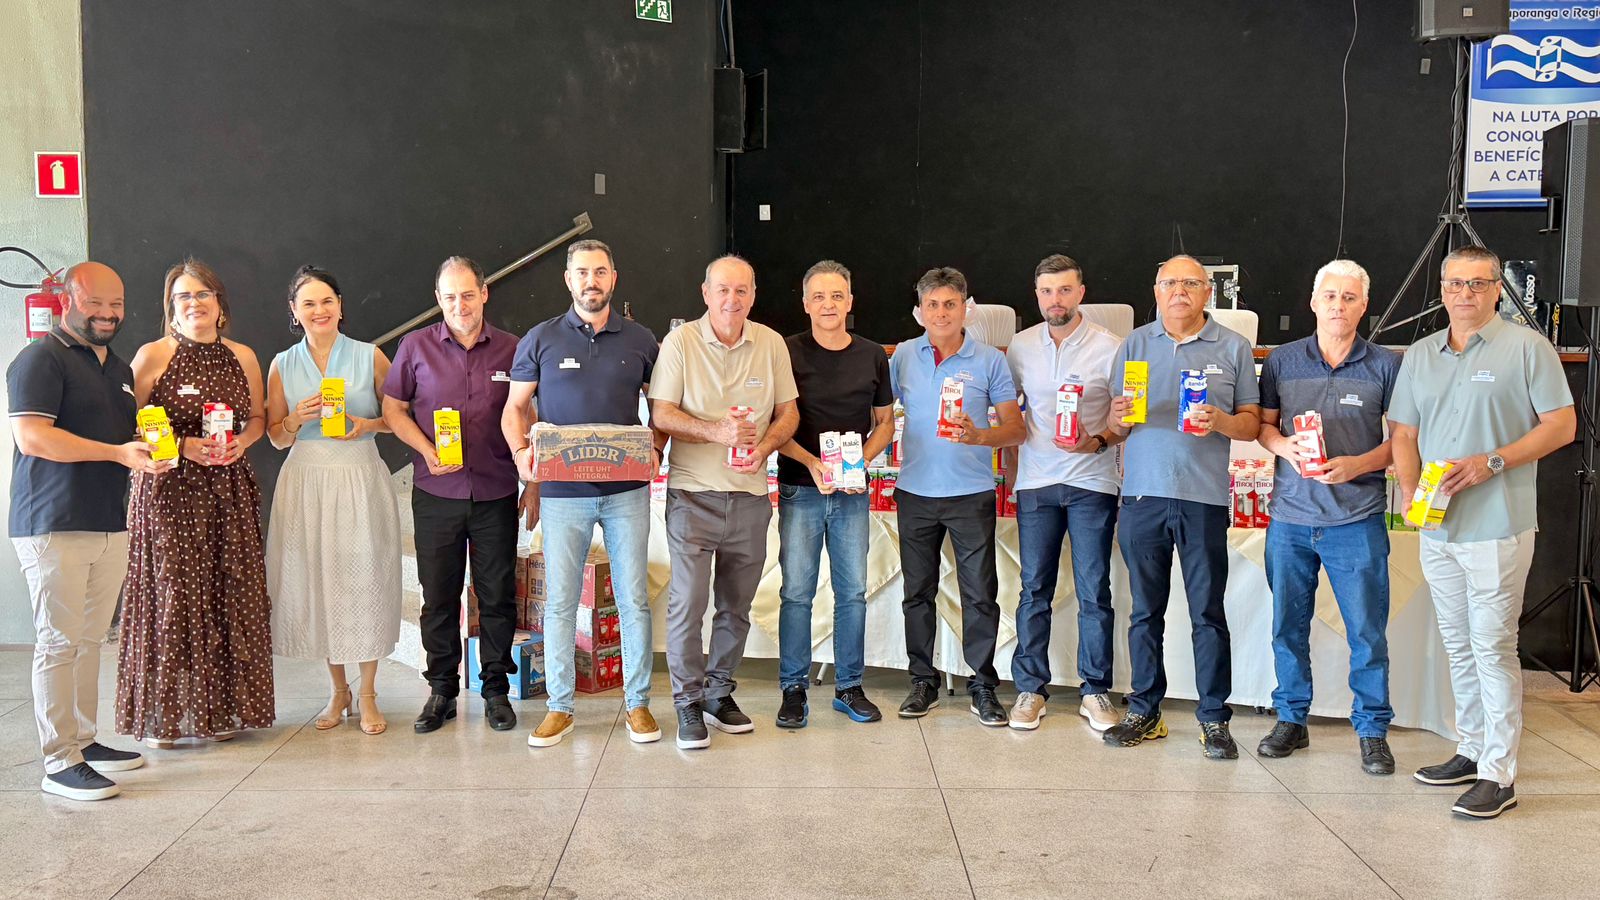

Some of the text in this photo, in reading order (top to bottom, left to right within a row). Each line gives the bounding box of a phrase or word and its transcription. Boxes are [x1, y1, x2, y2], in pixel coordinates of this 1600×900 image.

[1492, 110, 1516, 123] NA
[1521, 110, 1561, 123] LUTA
[1486, 130, 1543, 143] CONQU
[1474, 147, 1541, 162] BENEFÍC
[1489, 170, 1500, 182] A
[1523, 274, 1536, 308] Nosso
[145, 420, 168, 428] NINHO
[567, 446, 619, 462] LIDER
[541, 467, 550, 477] 12
